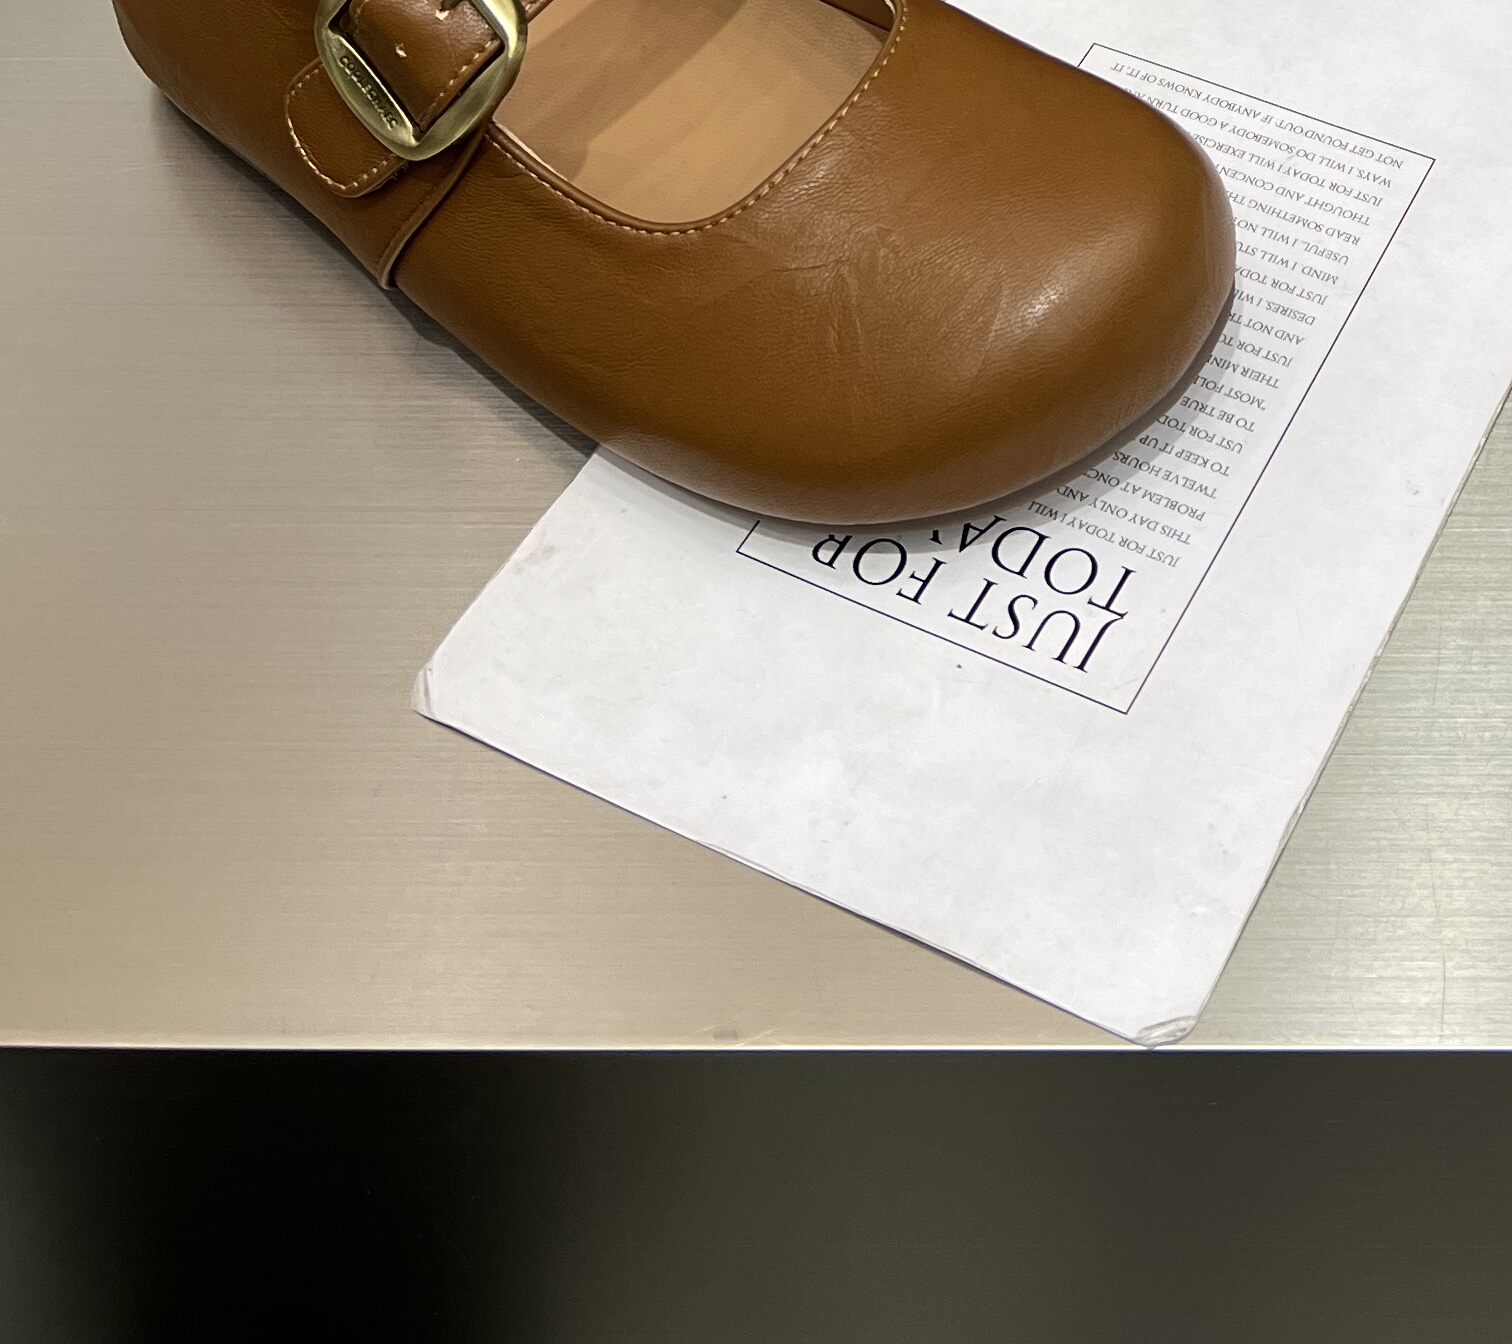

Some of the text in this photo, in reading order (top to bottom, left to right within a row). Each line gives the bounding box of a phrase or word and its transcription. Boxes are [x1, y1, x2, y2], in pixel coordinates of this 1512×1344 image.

[1110, 62, 1124, 73] IT
[1139, 72, 1157, 83] OF
[1156, 77, 1203, 99] KNOWS
[1201, 93, 1261, 118] ANYBODY
[1179, 108, 1217, 126] GOOD
[1220, 120, 1229, 129] A
[1259, 114, 1274, 124] IF
[1275, 119, 1303, 134] OUT
[1227, 125, 1296, 154] SOMEBODY
[1304, 129, 1349, 150] FOUND
[1295, 148, 1316, 161] DO
[1348, 144, 1374, 158] GET
[1248, 152, 1275, 170] WILL
[1276, 163, 1283, 172] I
[1318, 155, 1345, 172] WILL
[1347, 166, 1354, 174] I
[1374, 153, 1403, 169] NOT
[1282, 166, 1325, 187] TODAY
[1328, 181, 1354, 196] FOR
[1352, 190, 1383, 206] JUST
[1179, 395, 1254, 432] TO BE TRUE
[1138, 434, 1229, 476] TO KEEP IT UP
[1111, 451, 1217, 499] TWELVE HOURS
[1088, 497, 1128, 518] ONLY
[1059, 512, 1067, 523] I
[1127, 513, 1159, 531] DAY
[1065, 516, 1115, 543] TODAY
[1159, 524, 1190, 545] THIS
[1118, 535, 1147, 554] FOR
[1145, 548, 1180, 567] JUST
[929, 514, 1137, 620] TODA
[947, 577, 1128, 673] JUST
